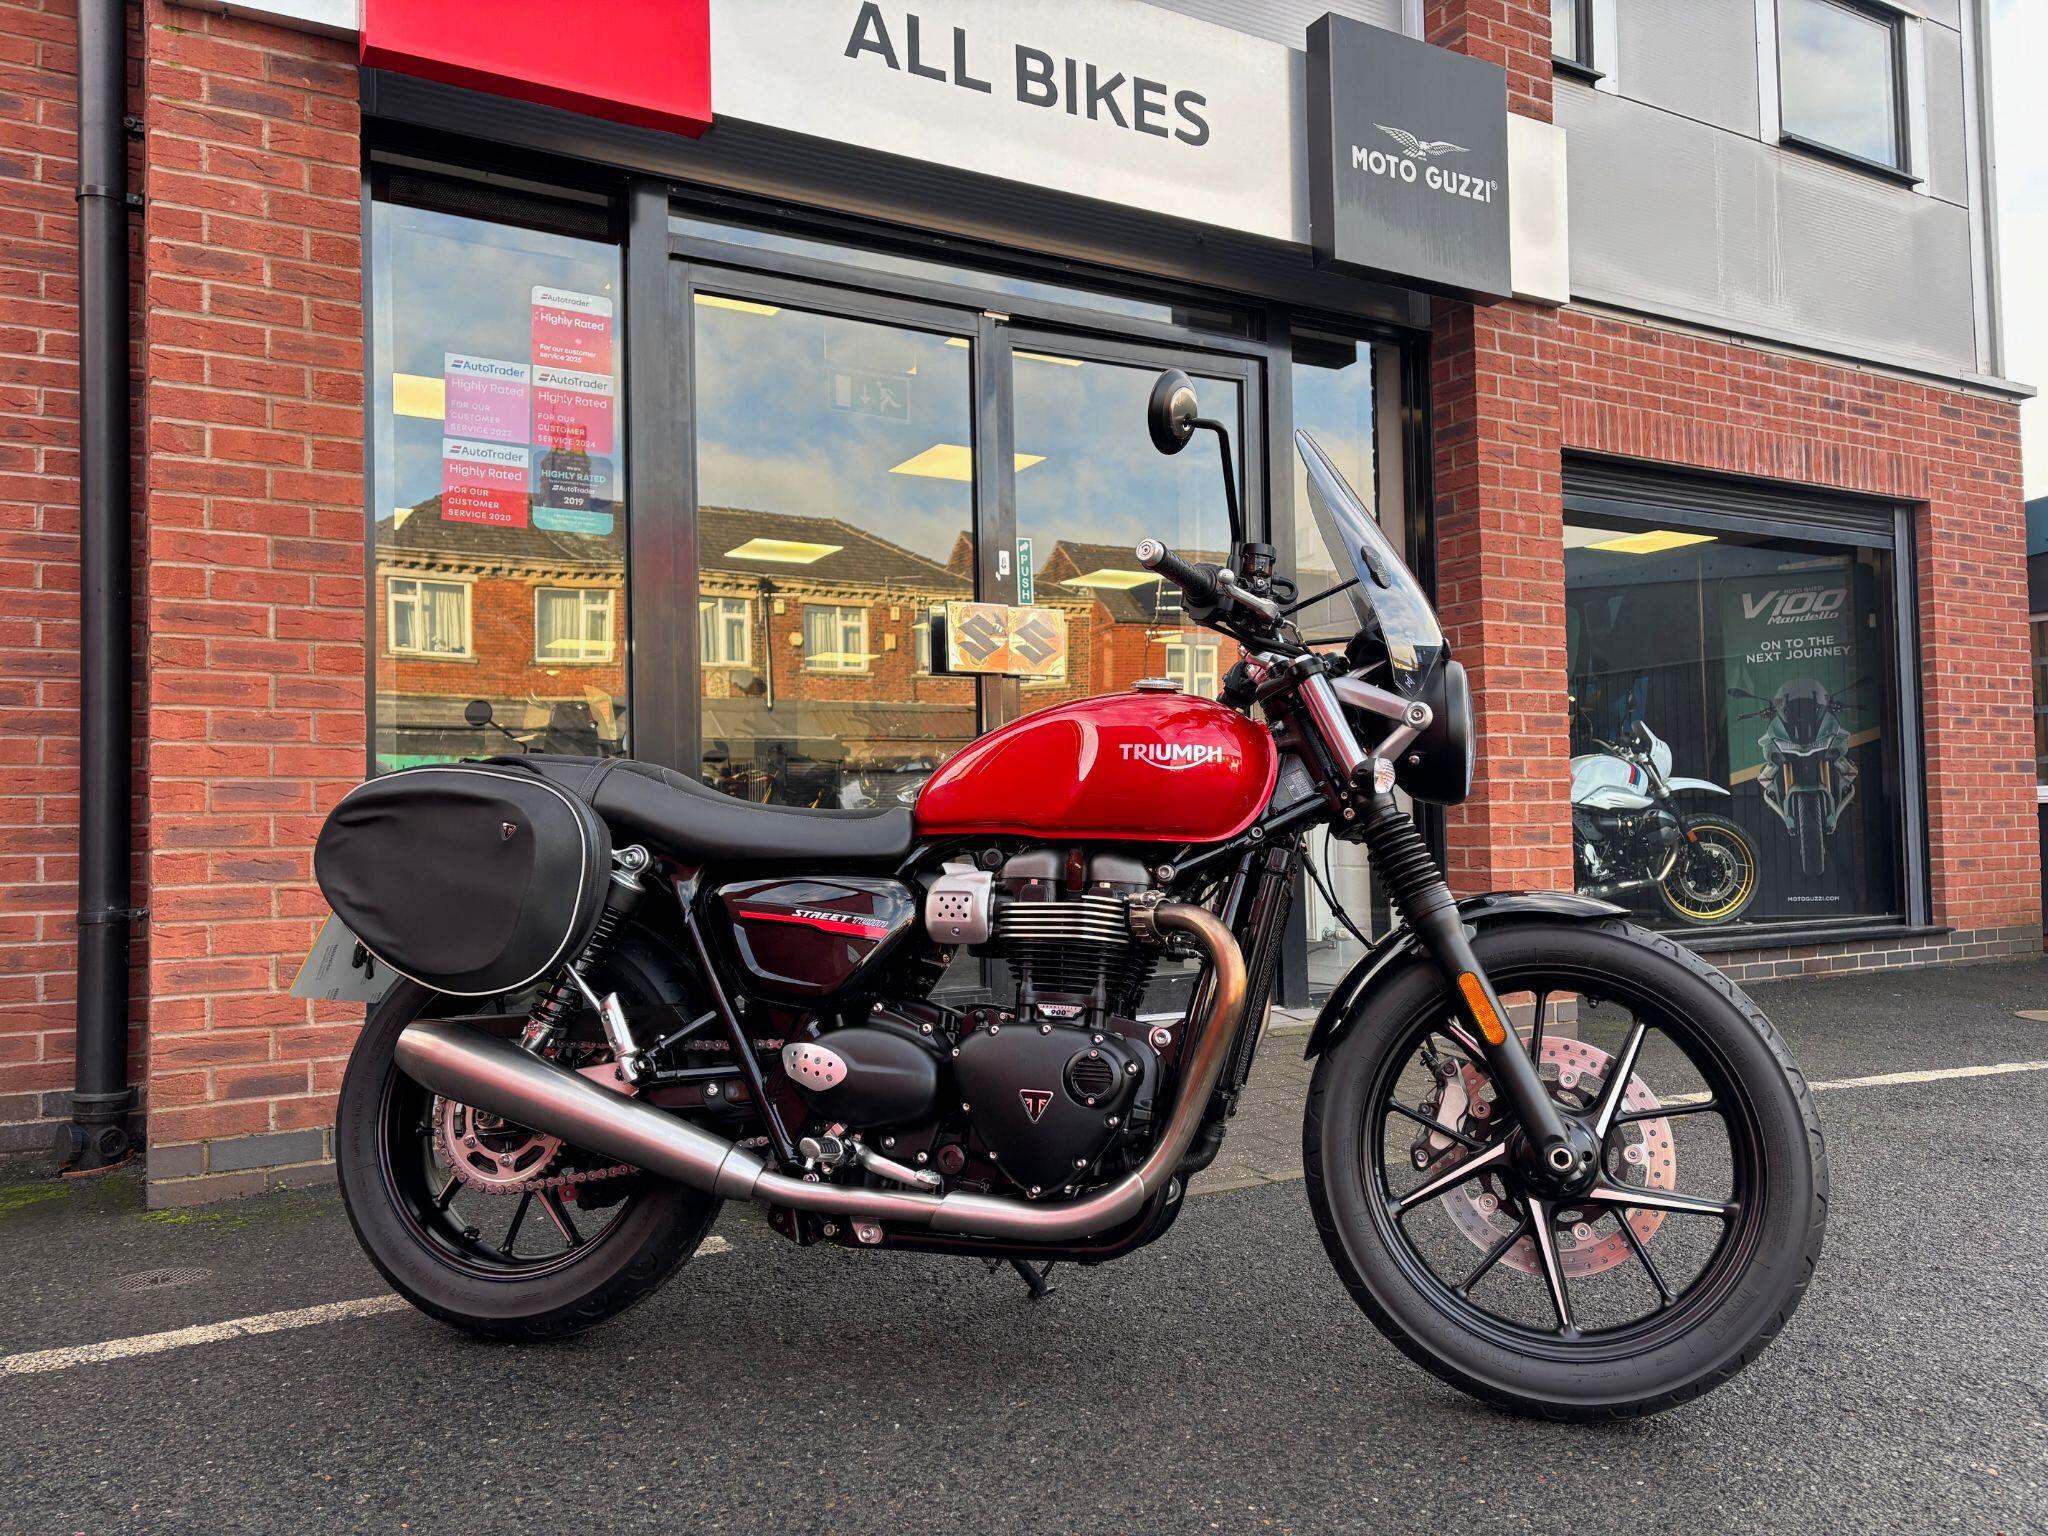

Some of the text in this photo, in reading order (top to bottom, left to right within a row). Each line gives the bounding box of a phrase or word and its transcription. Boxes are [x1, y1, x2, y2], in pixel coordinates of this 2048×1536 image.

[844, 0, 1210, 147] ALL BIKES
[1352, 145, 1417, 183] MOTO
[547, 294, 590, 307] Autotrader
[540, 313, 604, 331] Highly Rated
[539, 343, 597, 358] For our customer
[539, 352, 566, 362] service
[463, 360, 525, 377] AutoTrader
[451, 379, 524, 397] Highly Rated
[549, 374, 608, 391] AutoTrader
[450, 399, 491, 412] FOR OUR
[538, 391, 607, 409] Highly Rated
[450, 411, 501, 424] CUSTOMER
[537, 412, 575, 424] FOR OUR
[450, 423, 488, 434] SERVICE
[537, 423, 586, 436] CUSTOMER
[537, 434, 596, 449] SERVICE 2024
[461, 446, 524, 462] AutoTrader
[449, 463, 522, 481] Highly Rated
[541, 469, 576, 480] HIGHLY
[576, 473, 607, 484] RATED
[448, 485, 489, 497] FOR OUR
[558, 485, 596, 496] AutoTrader
[448, 496, 500, 509] CUSTOMER
[563, 496, 585, 506] 2019
[447, 508, 512, 522] SERVICE 2020
[1019, 554, 1031, 600] PUSH
[1742, 588, 1848, 619] V100
[1767, 610, 1841, 625] Mandello
[1760, 635, 1835, 651] ON TO THE
[1746, 645, 1852, 664] NEXT JOURNEY
[1119, 743, 1223, 769] TRIUMPH
[791, 909, 852, 923] STREET
